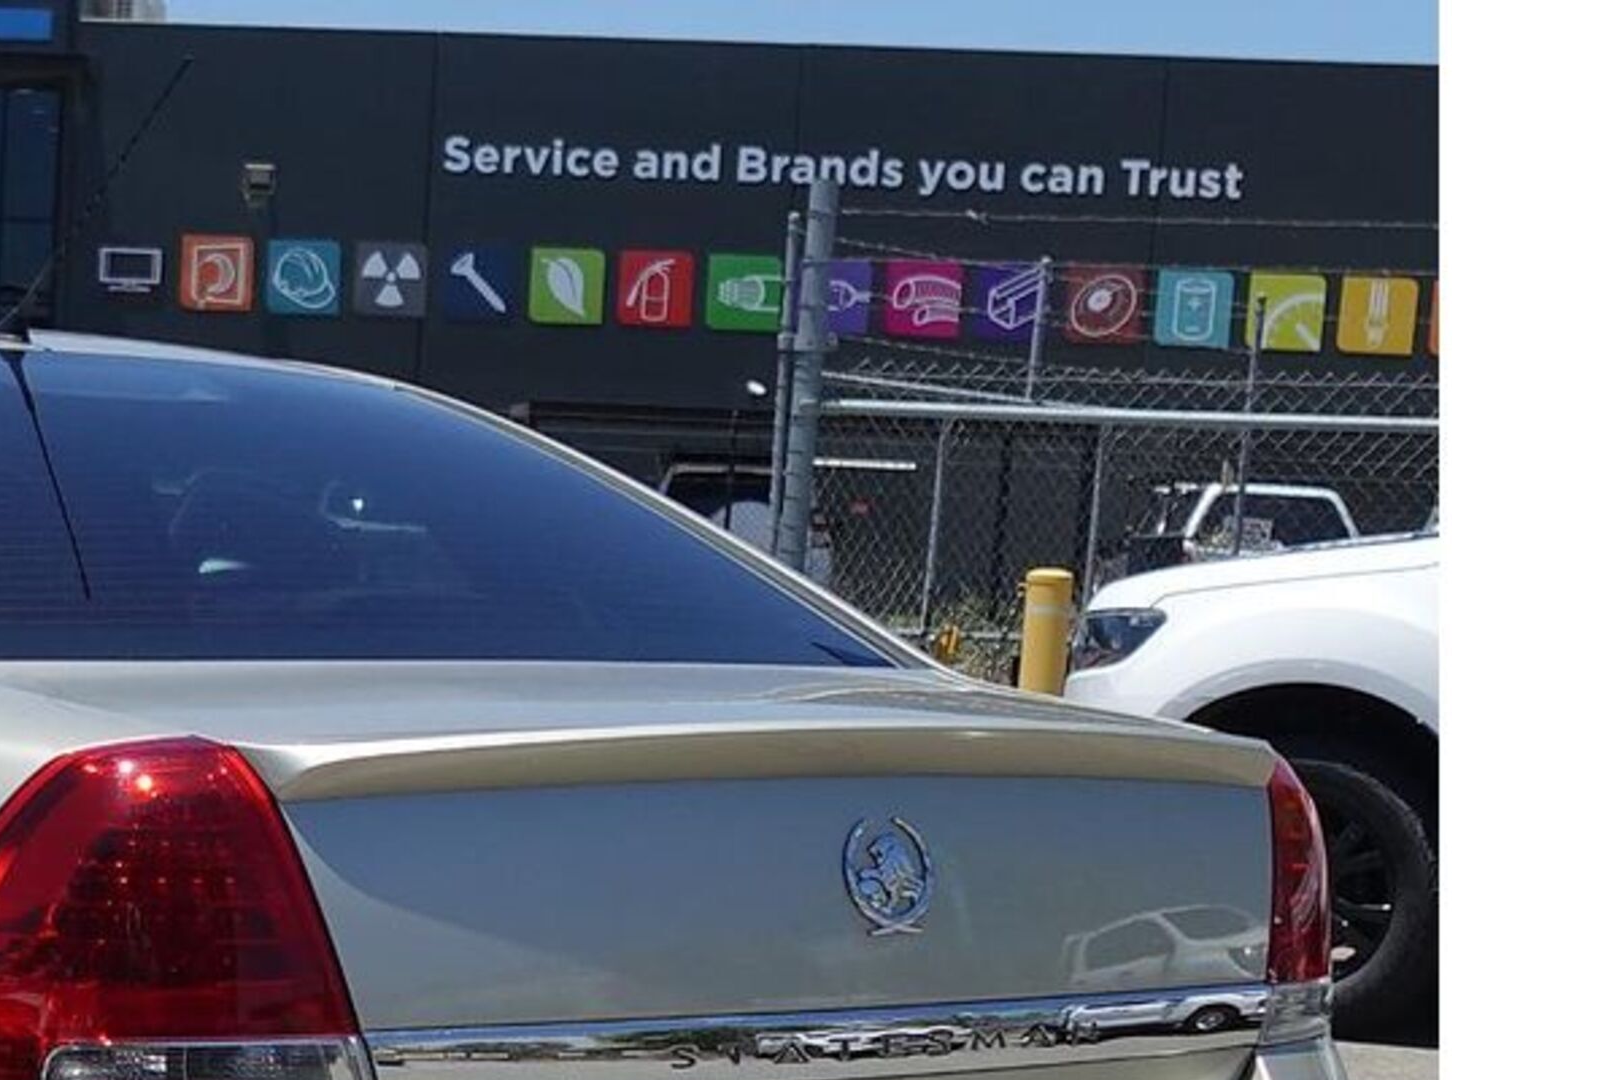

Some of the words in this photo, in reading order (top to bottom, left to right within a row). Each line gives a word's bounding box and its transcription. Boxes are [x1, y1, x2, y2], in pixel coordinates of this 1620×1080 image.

[443, 136, 620, 177] Service
[633, 143, 722, 180] and
[736, 146, 903, 187] Brands
[919, 158, 1005, 196] you
[1021, 163, 1104, 195] can
[1121, 159, 1243, 199] Trust
